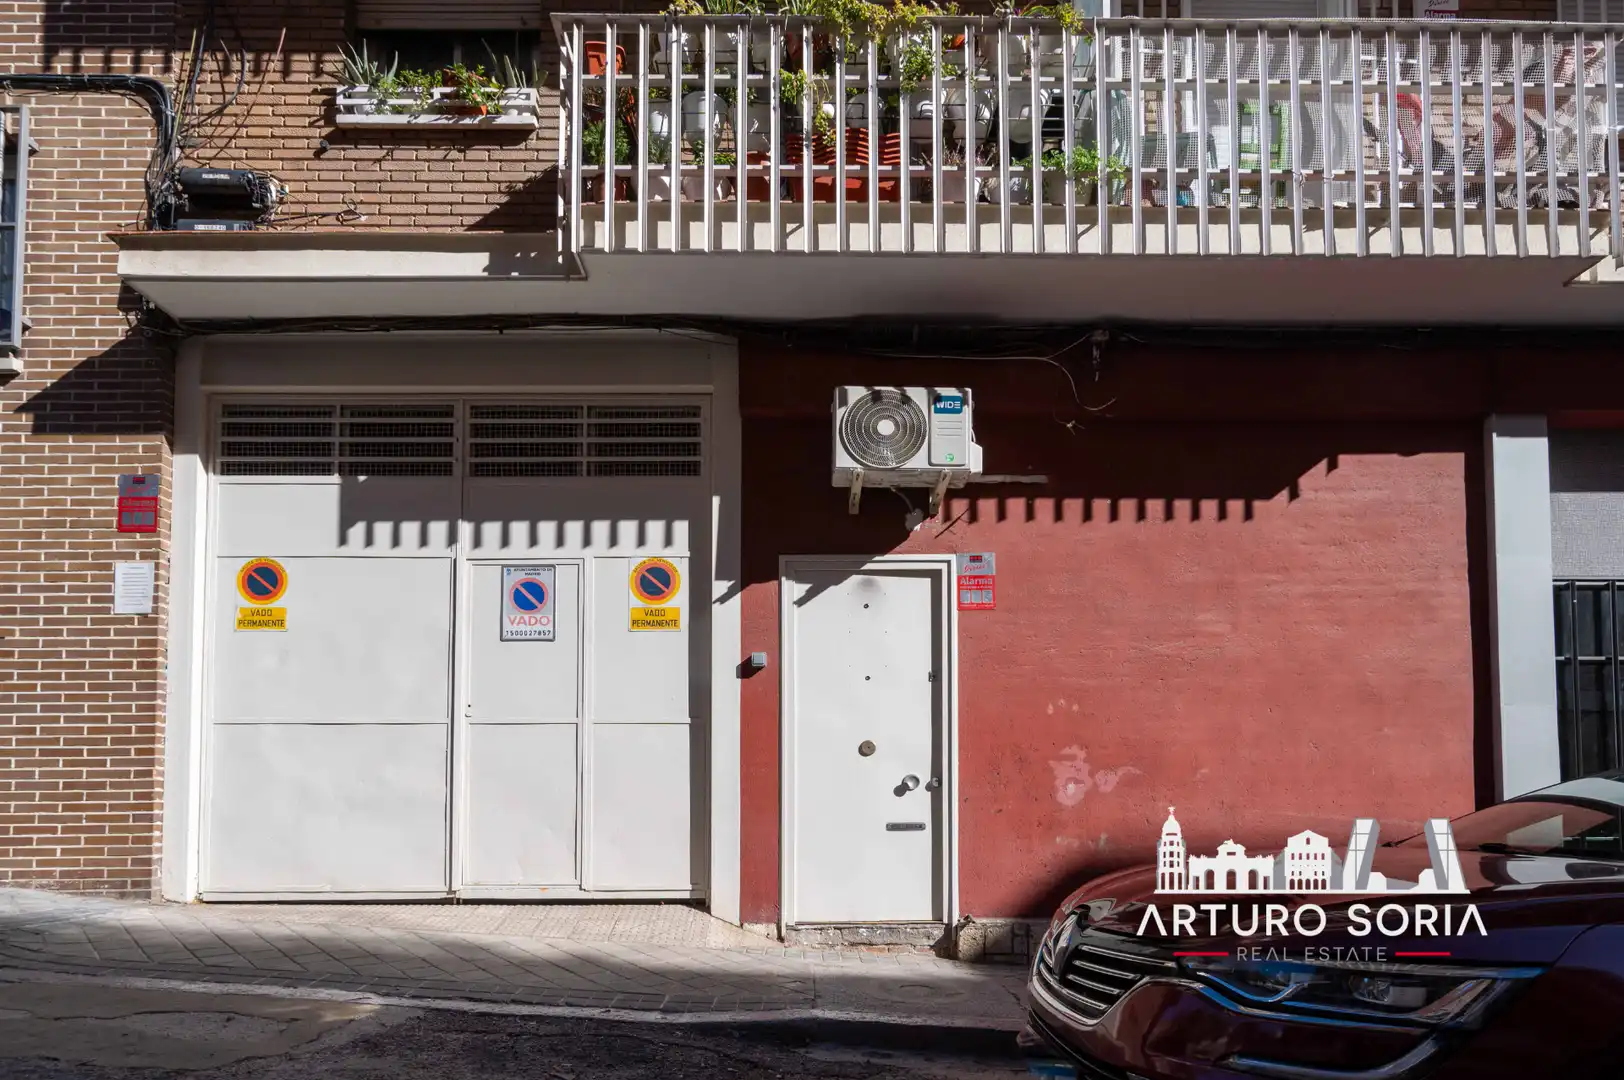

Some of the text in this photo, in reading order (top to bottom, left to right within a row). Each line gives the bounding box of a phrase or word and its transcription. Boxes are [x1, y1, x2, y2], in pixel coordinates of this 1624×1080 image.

[936, 401, 960, 409] WIDE
[960, 577, 993, 585] Alarma
[250, 609, 273, 617] VADO
[643, 609, 666, 617] VADO
[238, 619, 285, 628] PERMANENTE
[507, 615, 551, 627] VADO
[631, 619, 678, 628] PERMANENTE
